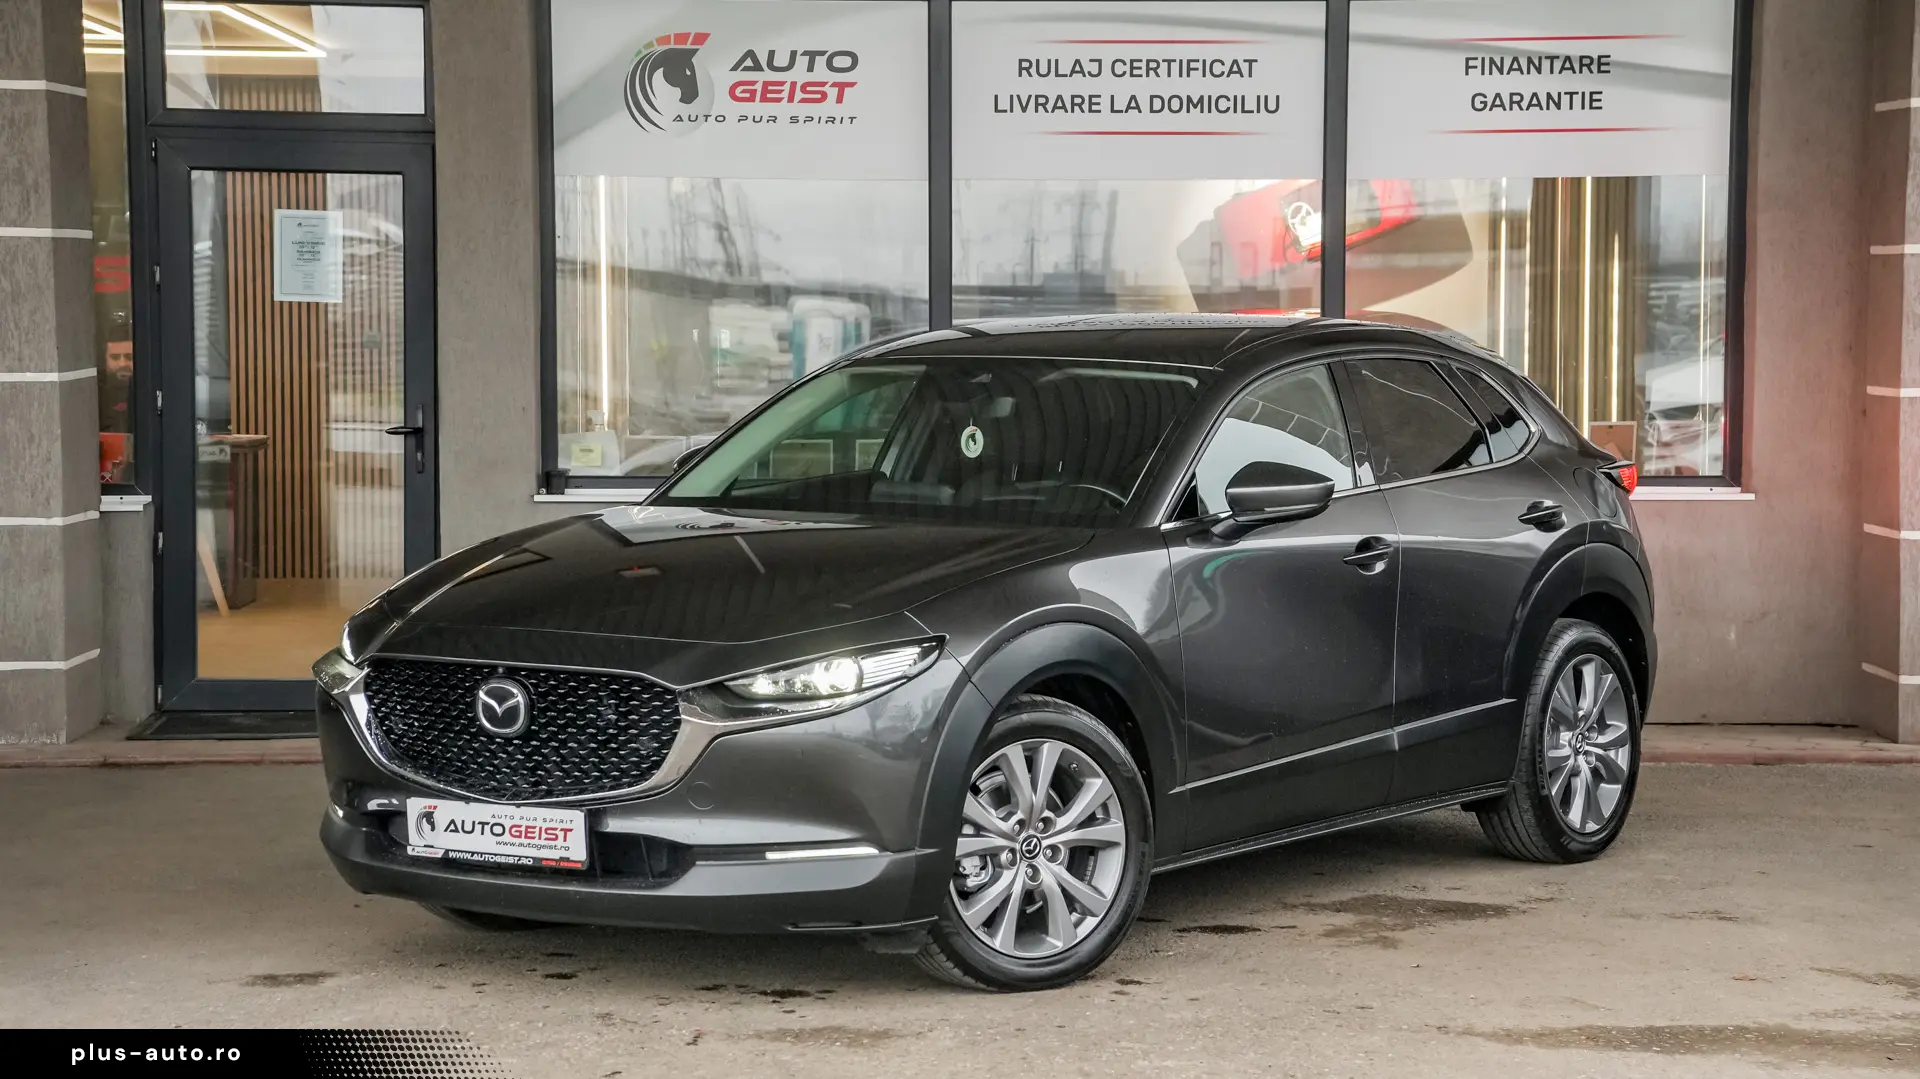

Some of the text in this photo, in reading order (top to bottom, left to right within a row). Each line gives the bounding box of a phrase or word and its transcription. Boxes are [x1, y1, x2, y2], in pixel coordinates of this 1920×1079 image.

[729, 49, 859, 73] AUTO
[1018, 58, 1258, 78] RULAJ CERTIFICAT
[1464, 54, 1612, 76] FINANTARE
[728, 80, 858, 104] GEIST
[1470, 90, 1603, 112] GARANTIE
[993, 94, 1281, 114] LIVRARE LA DOMICILIU
[672, 114, 858, 125] AUTO PUR SPIRIT
[490, 813, 574, 825] AUTO PUR SPIRIT
[495, 839, 570, 852] www.autogeist.ro
[448, 851, 533, 865] WWW.AUTOGEIST.RO
